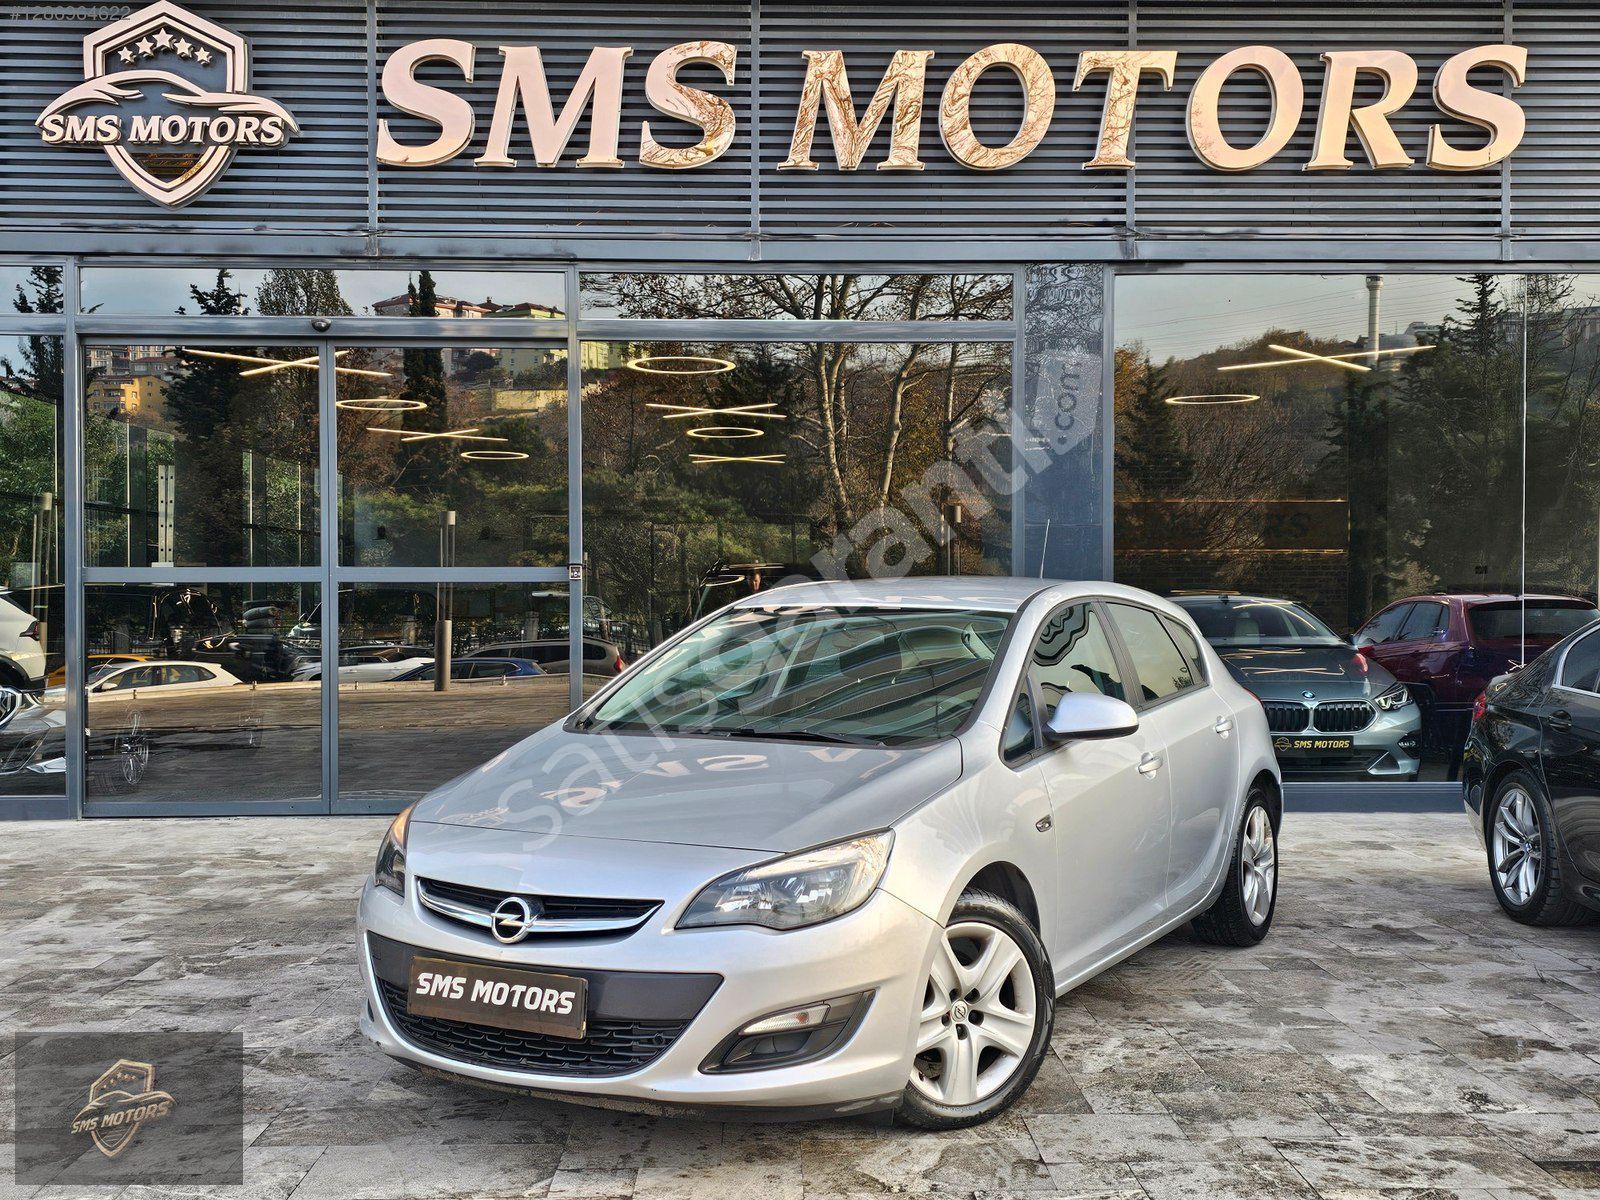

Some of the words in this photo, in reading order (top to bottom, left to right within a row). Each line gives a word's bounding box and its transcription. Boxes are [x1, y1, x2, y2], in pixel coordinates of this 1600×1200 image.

[375, 38, 738, 170] SMS
[776, 42, 1529, 173] MOTORS
[41, 113, 122, 145] SMS
[127, 114, 286, 146] MOTORS
[1293, 740, 1313, 749] SMS
[1314, 740, 1351, 749] MOTORS
[415, 972, 467, 1000] SMS
[470, 979, 576, 1015] MOTORS
